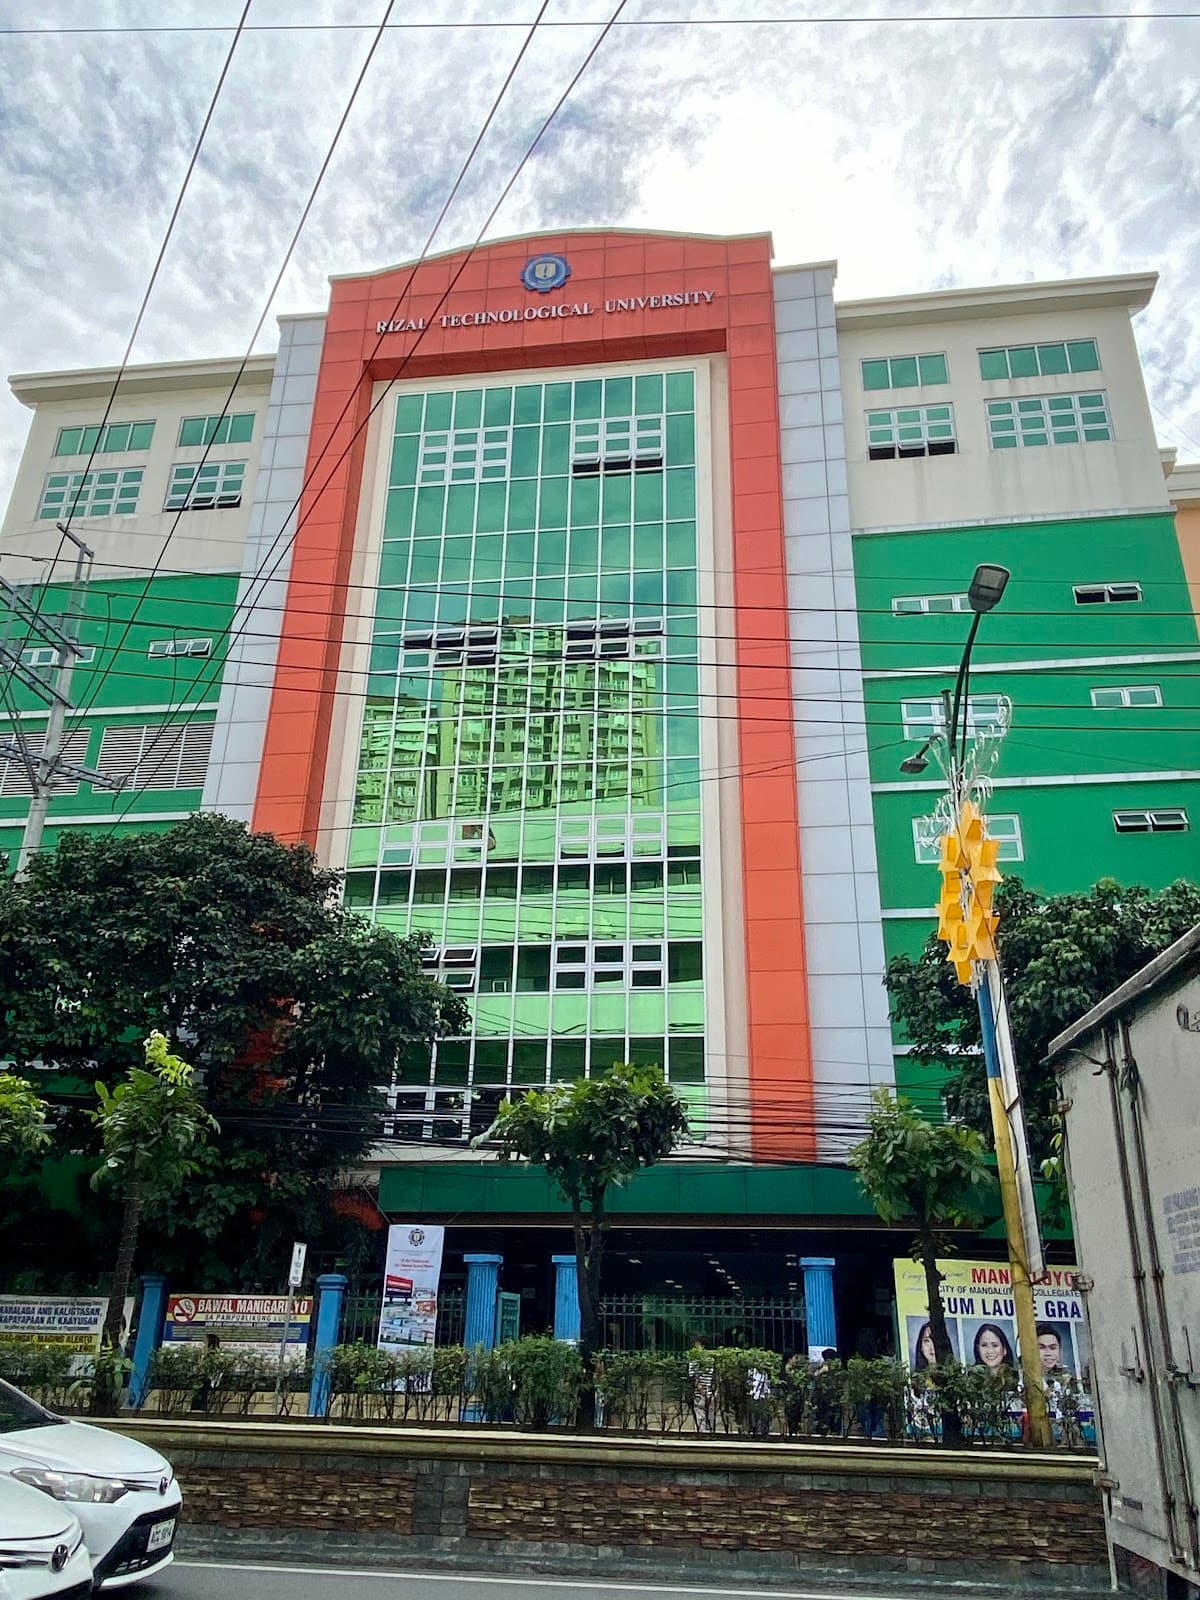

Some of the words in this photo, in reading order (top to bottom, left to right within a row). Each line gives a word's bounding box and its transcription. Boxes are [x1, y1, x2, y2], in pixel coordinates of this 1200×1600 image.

[376, 318, 426, 334] RIZAL
[440, 303, 594, 328] TECHNOLOGICAL
[605, 290, 715, 313] UNIVERSITY
[957, 1286, 967, 1294] OF
[198, 1299, 233, 1313] BAWAL
[237, 1299, 308, 1314] MANIGARIYO
[942, 1297, 975, 1316] UM
[1045, 1300, 1082, 1319] GRA
